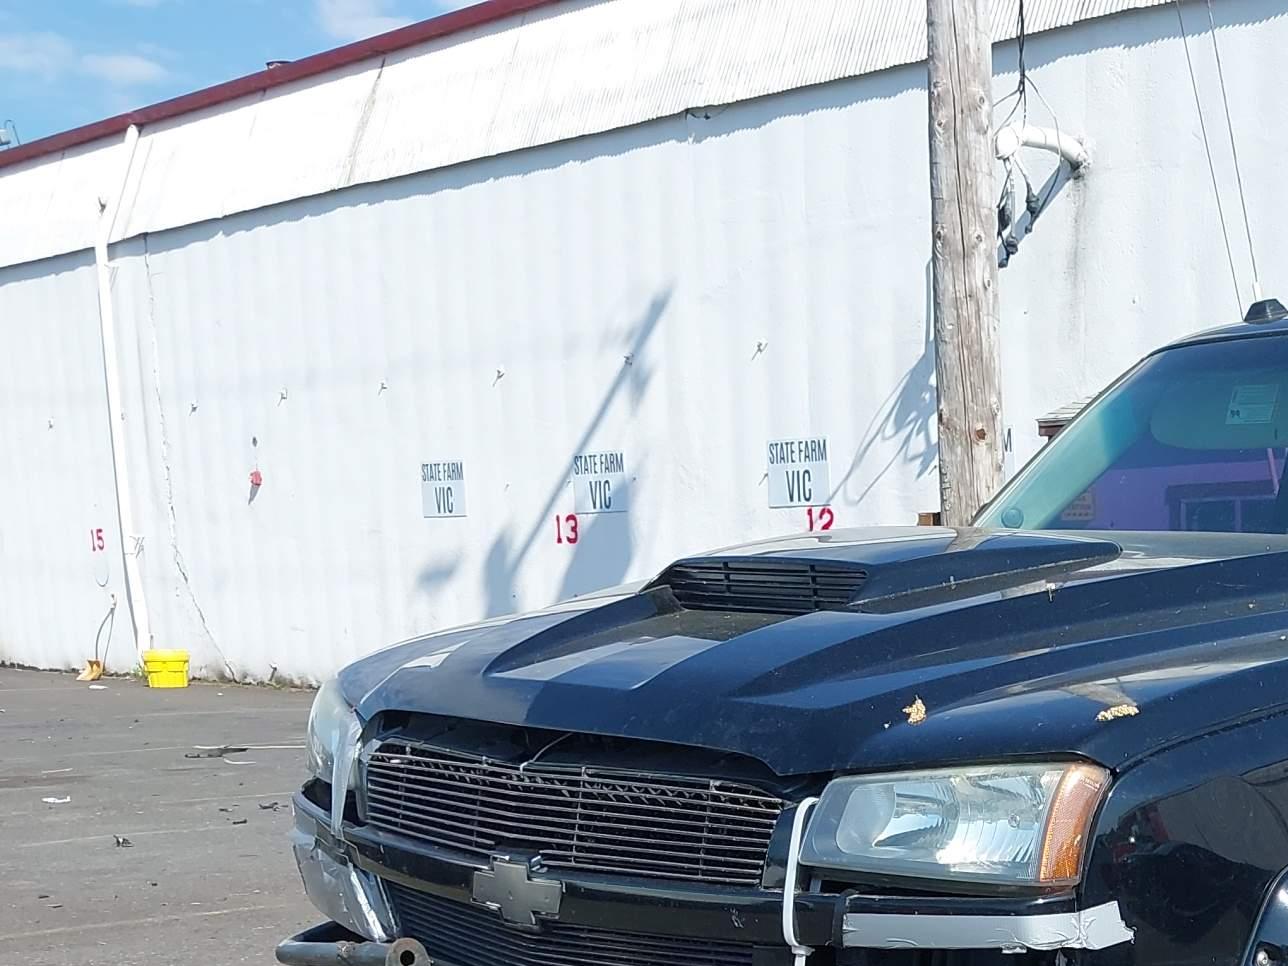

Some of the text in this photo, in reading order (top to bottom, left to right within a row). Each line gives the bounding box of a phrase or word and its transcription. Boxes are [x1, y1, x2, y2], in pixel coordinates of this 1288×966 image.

[574, 452, 624, 475] STATE FARM
[769, 439, 827, 465] STATE FARM
[422, 461, 464, 481] STATE FARM
[589, 479, 612, 510] VIC
[785, 470, 812, 502] VIC
[434, 486, 454, 514] VIC
[556, 514, 578, 544] 13
[807, 507, 834, 532] 12
[90, 528, 105, 552] 15
